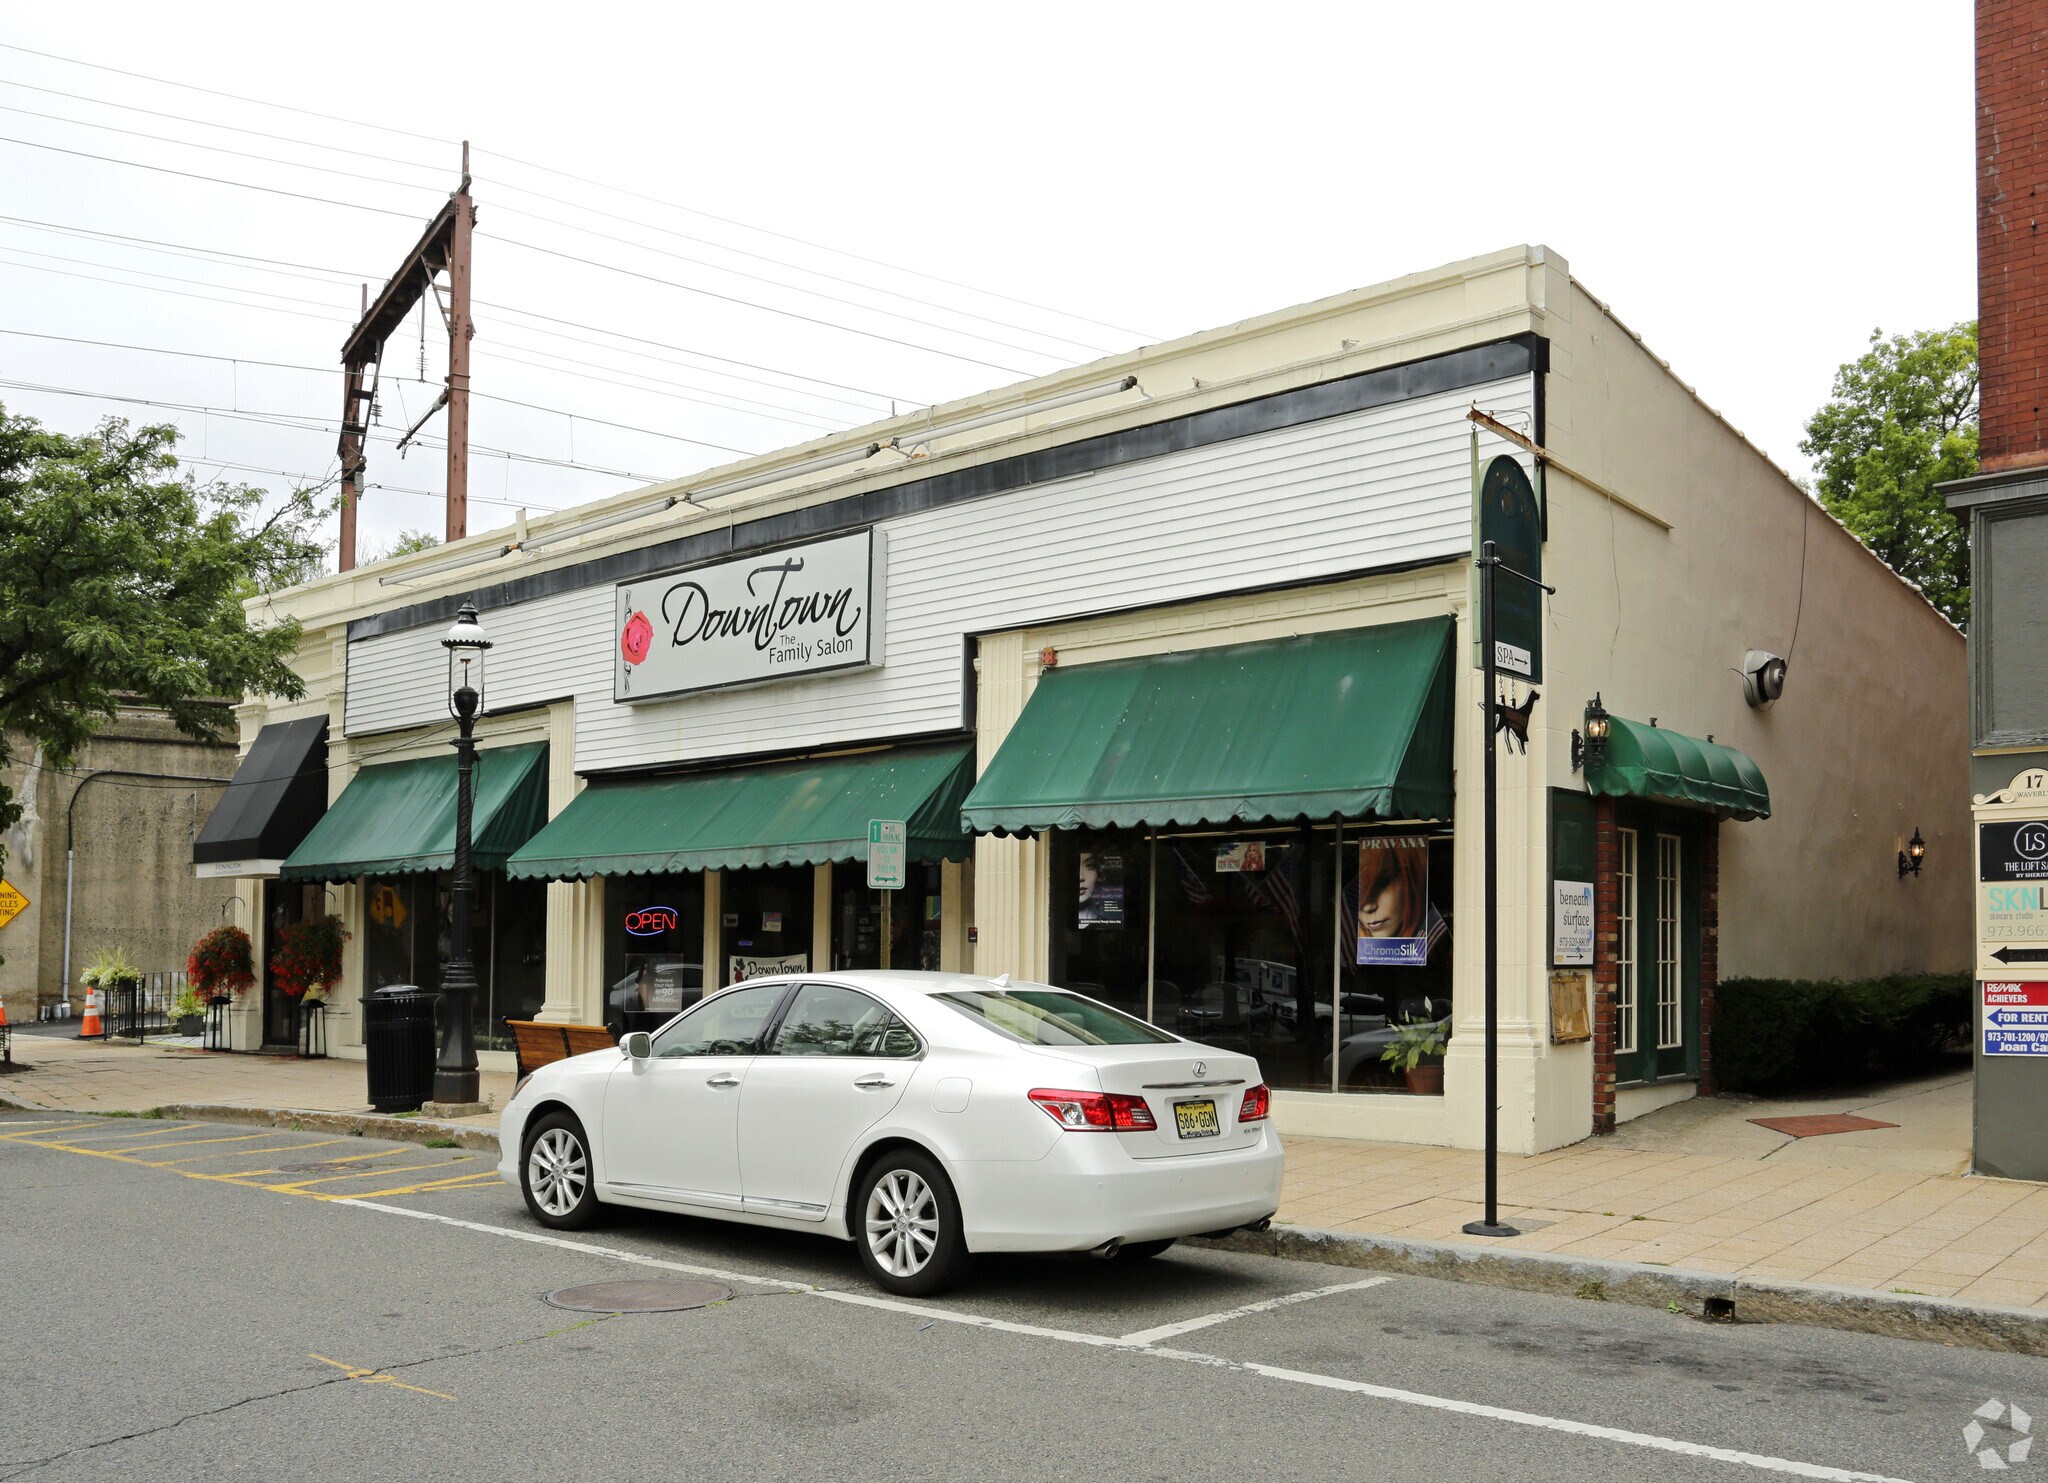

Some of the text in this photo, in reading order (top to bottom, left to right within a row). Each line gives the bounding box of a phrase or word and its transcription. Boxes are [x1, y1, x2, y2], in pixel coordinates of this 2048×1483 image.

[780, 635, 796, 646] The
[769, 636, 853, 664] Family Salon
[1497, 646, 1514, 666] SPA
[2026, 774, 2043, 788] 17
[2017, 790, 2048, 799] WAVERL
[872, 825, 878, 841] 1
[1361, 838, 1426, 849] PRAVANA
[2024, 832, 2046, 851] LS
[2004, 862, 2019, 872] THE
[2021, 861, 2039, 871] LOFT
[1559, 887, 1589, 906] beneath
[625, 912, 676, 930] OPEN
[1989, 912, 2033, 920] skincare studio
[1563, 911, 1590, 934] surface
[1363, 943, 1418, 956] ChromaSilk
[661, 988, 674, 998] 90
[1987, 994, 2028, 1003] ACHIEVERS
[1998, 1013, 2048, 1022] FOR RENT
[1999, 1042, 2028, 1052] Joan
